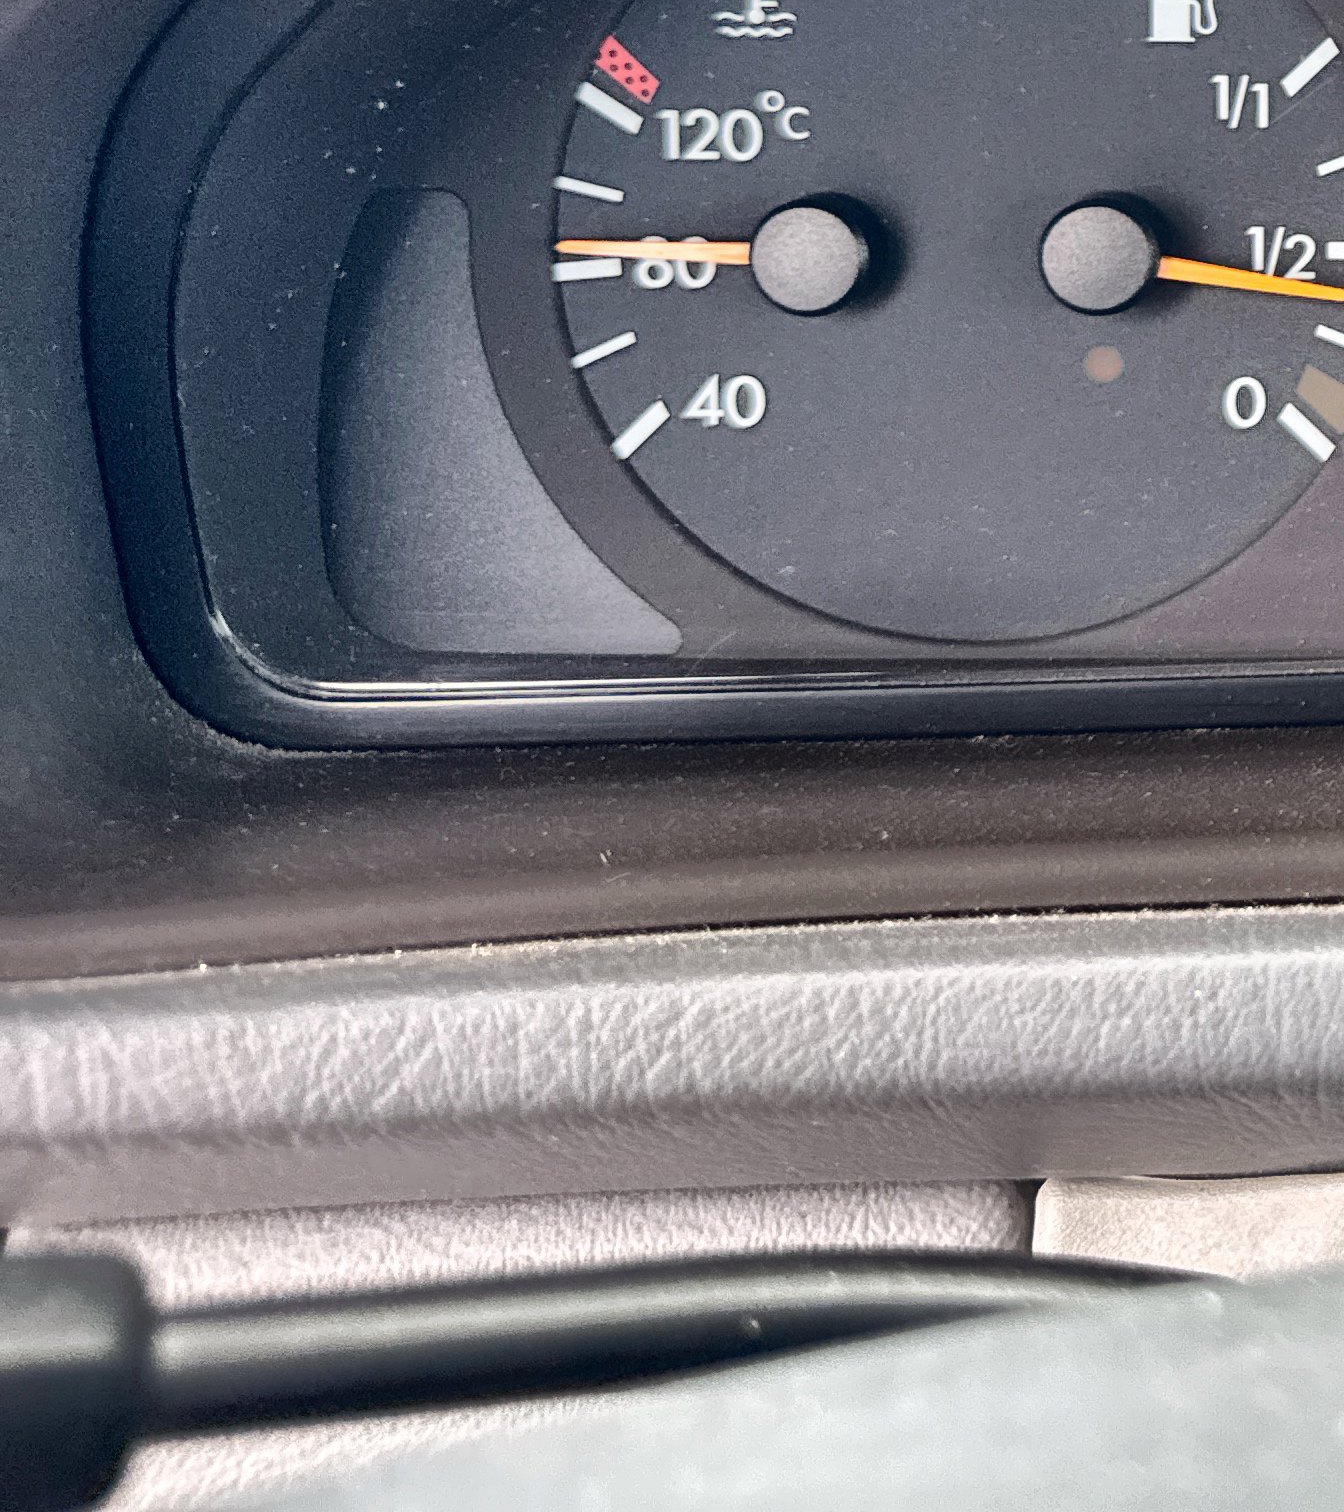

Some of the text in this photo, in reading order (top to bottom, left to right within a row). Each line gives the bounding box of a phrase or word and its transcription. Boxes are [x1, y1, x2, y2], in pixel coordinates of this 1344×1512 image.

[1210, 74, 1269, 129] 1/1
[1245, 225, 1316, 280] 1/2
[680, 373, 766, 429] 40
[1223, 376, 1267, 429] 0
